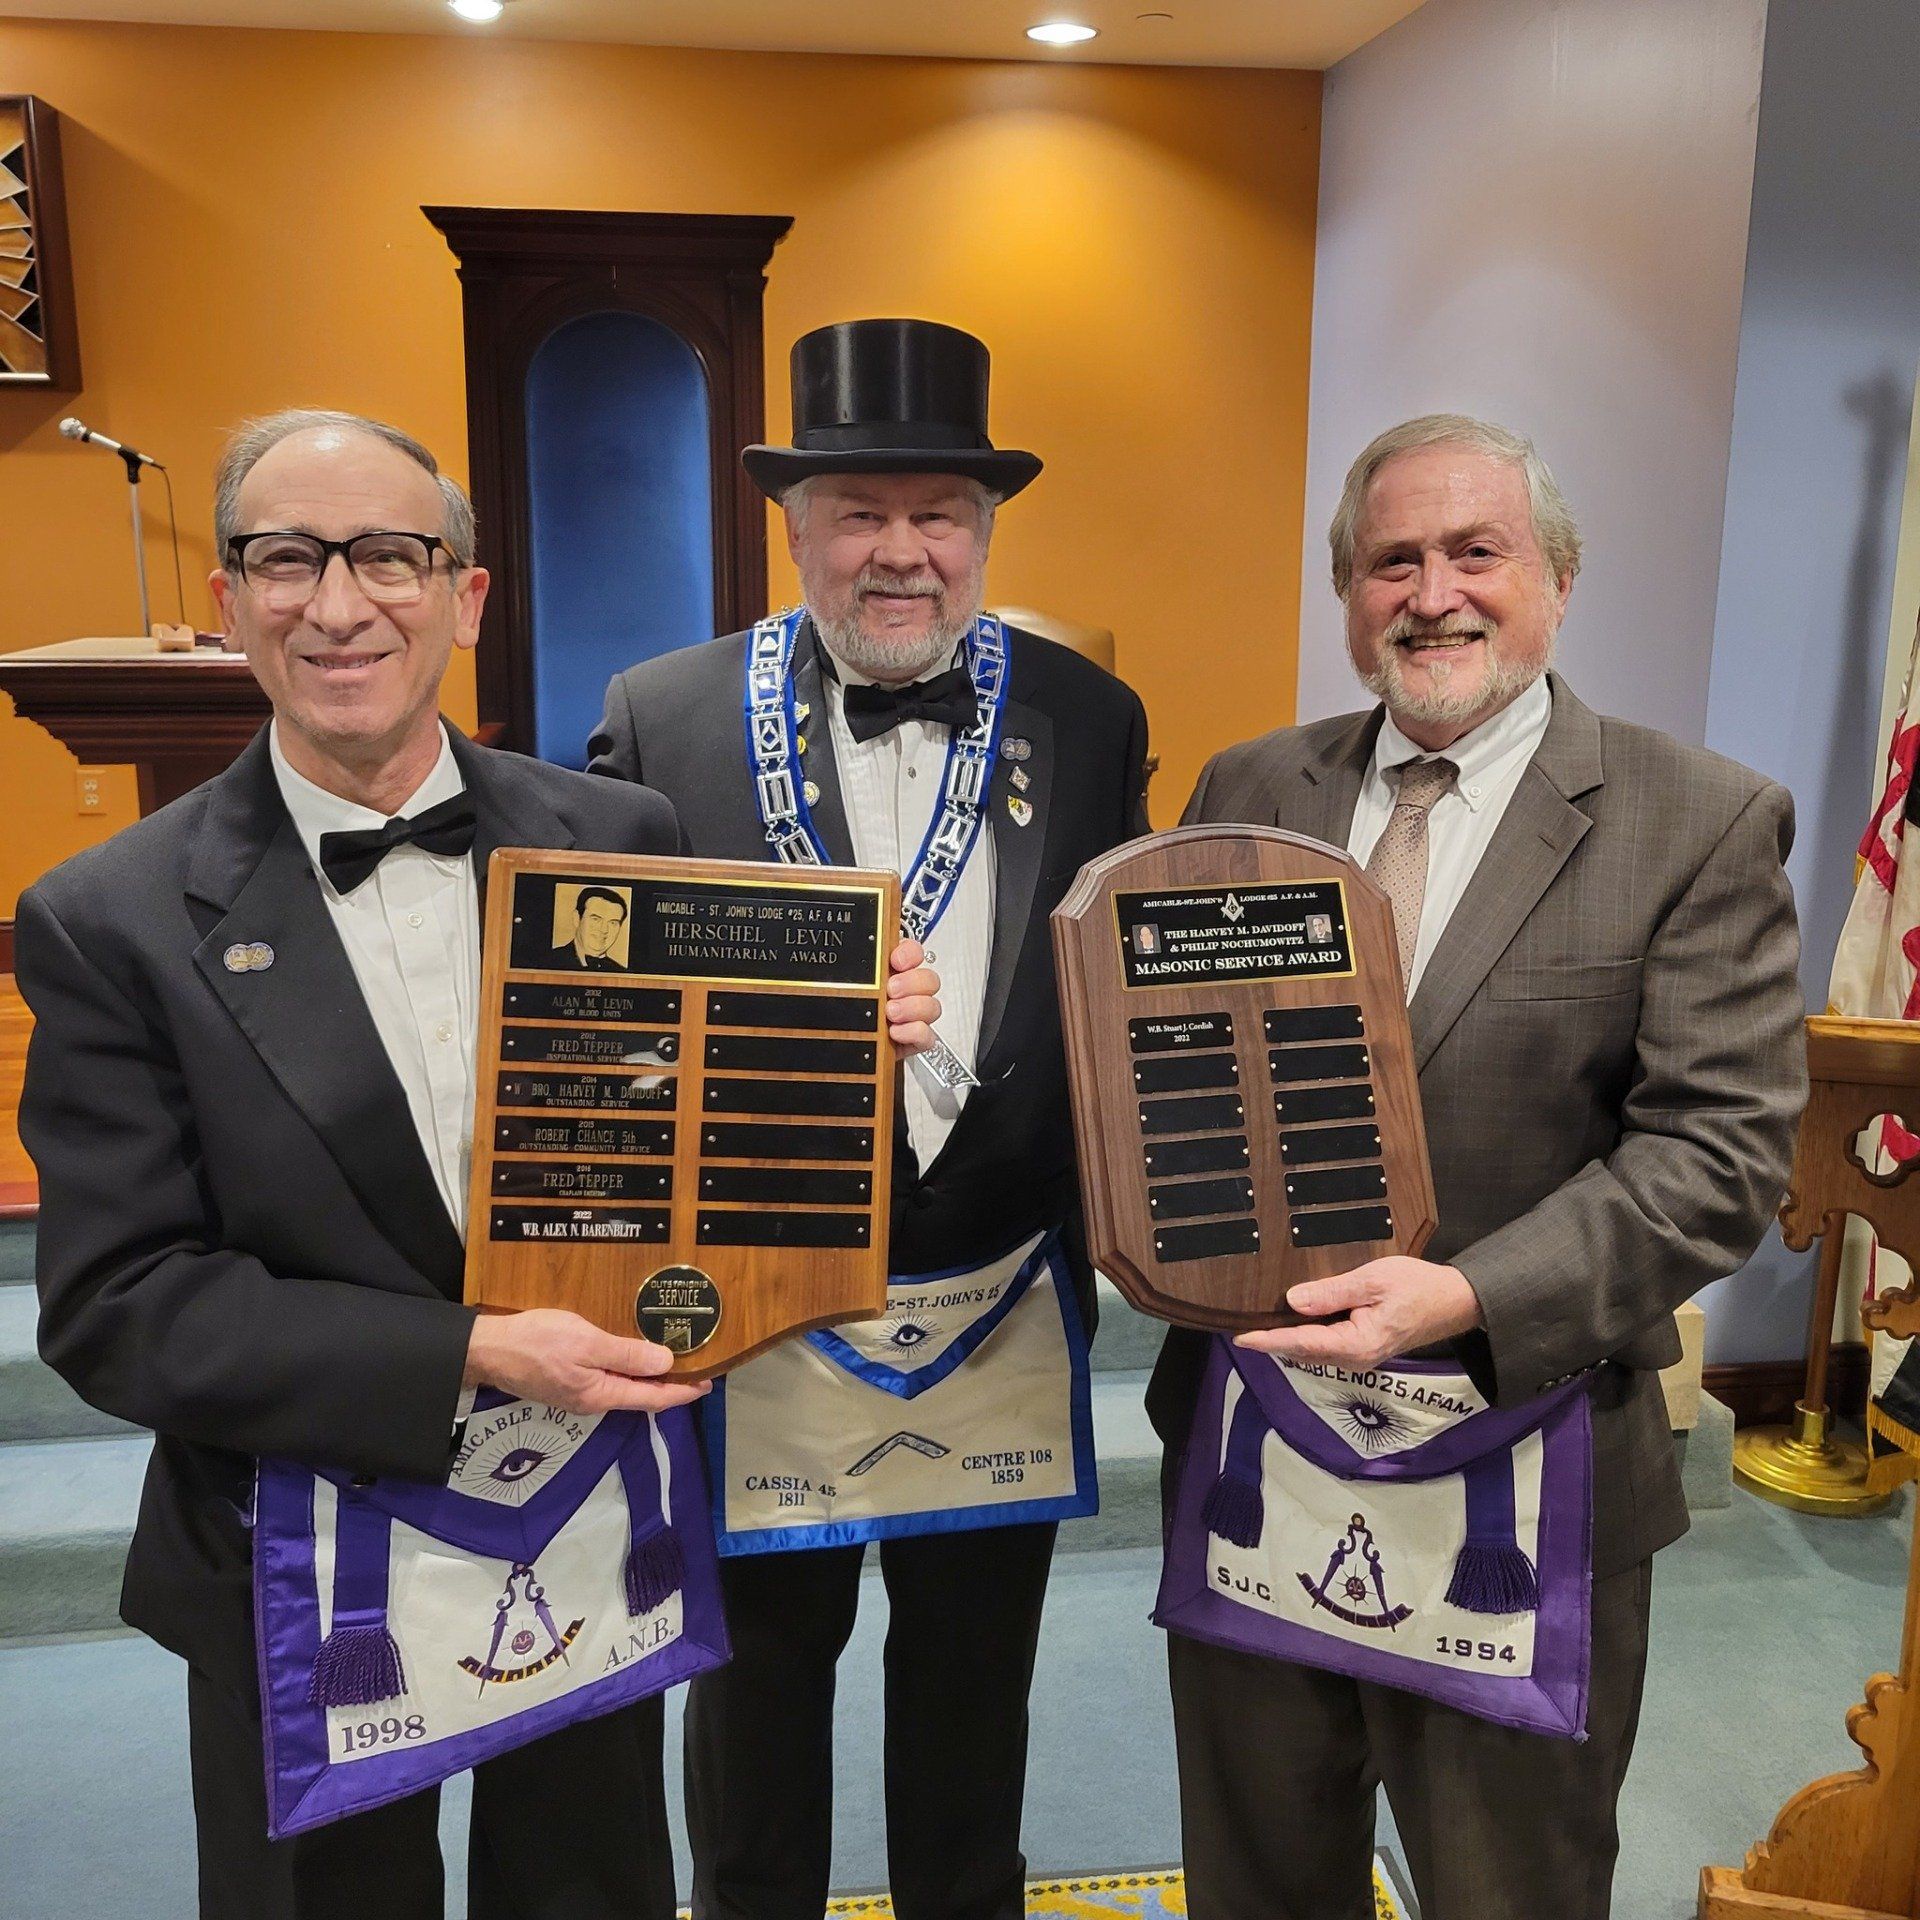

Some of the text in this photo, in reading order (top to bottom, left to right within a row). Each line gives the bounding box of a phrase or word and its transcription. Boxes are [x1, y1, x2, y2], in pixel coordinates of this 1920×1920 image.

[656, 902, 695, 915] AMICABLE
[709, 905, 721, 917] ST.
[726, 906, 754, 918] JOHN'S
[758, 907, 784, 920] LODGE
[809, 909, 823, 923] A.F.
[827, 911, 833, 922] &
[664, 922, 844, 946] HERSCHEL LEVIN
[1164, 923, 1305, 939] THE HARVEY M. DAVIDOFF
[1170, 936, 1304, 953] & PHILIP NOCHUMOWITZ
[669, 945, 838, 964] HUMANITARIAN AWARD
[1135, 950, 1342, 975] MASONIC SERVICE AWARD
[552, 997, 580, 1008] ALAN
[604, 999, 635, 1010] LEVIN
[1163, 1024, 1182, 1032] Stuart
[1183, 1024, 1188, 1033] J.
[1189, 1022, 1214, 1030] Cordish
[552, 1040, 624, 1054] FRED TEPPER
[532, 1083, 551, 1096] BRO.
[559, 1084, 597, 1098] HARVEY
[604, 1085, 614, 1099] M.
[546, 1099, 630, 1108] OUTSTANDING SERVICE
[535, 1128, 636, 1144] ROBERT CHANCE 5th
[519, 1143, 651, 1153] OUTSTANDING COMMUNITY SERVICE
[543, 1173, 624, 1188] FRED TEPPER
[573, 1211, 592, 1220] 2022
[543, 1223, 568, 1237] ALEX
[582, 1224, 642, 1238] BARENBLITT
[651, 1280, 708, 1289] OUTSTANDING
[988, 1283, 1001, 1300] 25
[659, 1289, 699, 1306] SERVICE
[451, 1406, 583, 1478] AMICABLE NO. 25
[962, 1449, 1052, 1470] CENTRE 108
[991, 1468, 1024, 1484] 1859
[746, 1476, 836, 1497] CASSIA 45
[778, 1493, 805, 1506] 1811
[1217, 1566, 1276, 1603] S.J.C.
[603, 1618, 675, 1672] A.N.B.
[1436, 1636, 1516, 1664] 1994
[342, 1714, 427, 1755] 1998
